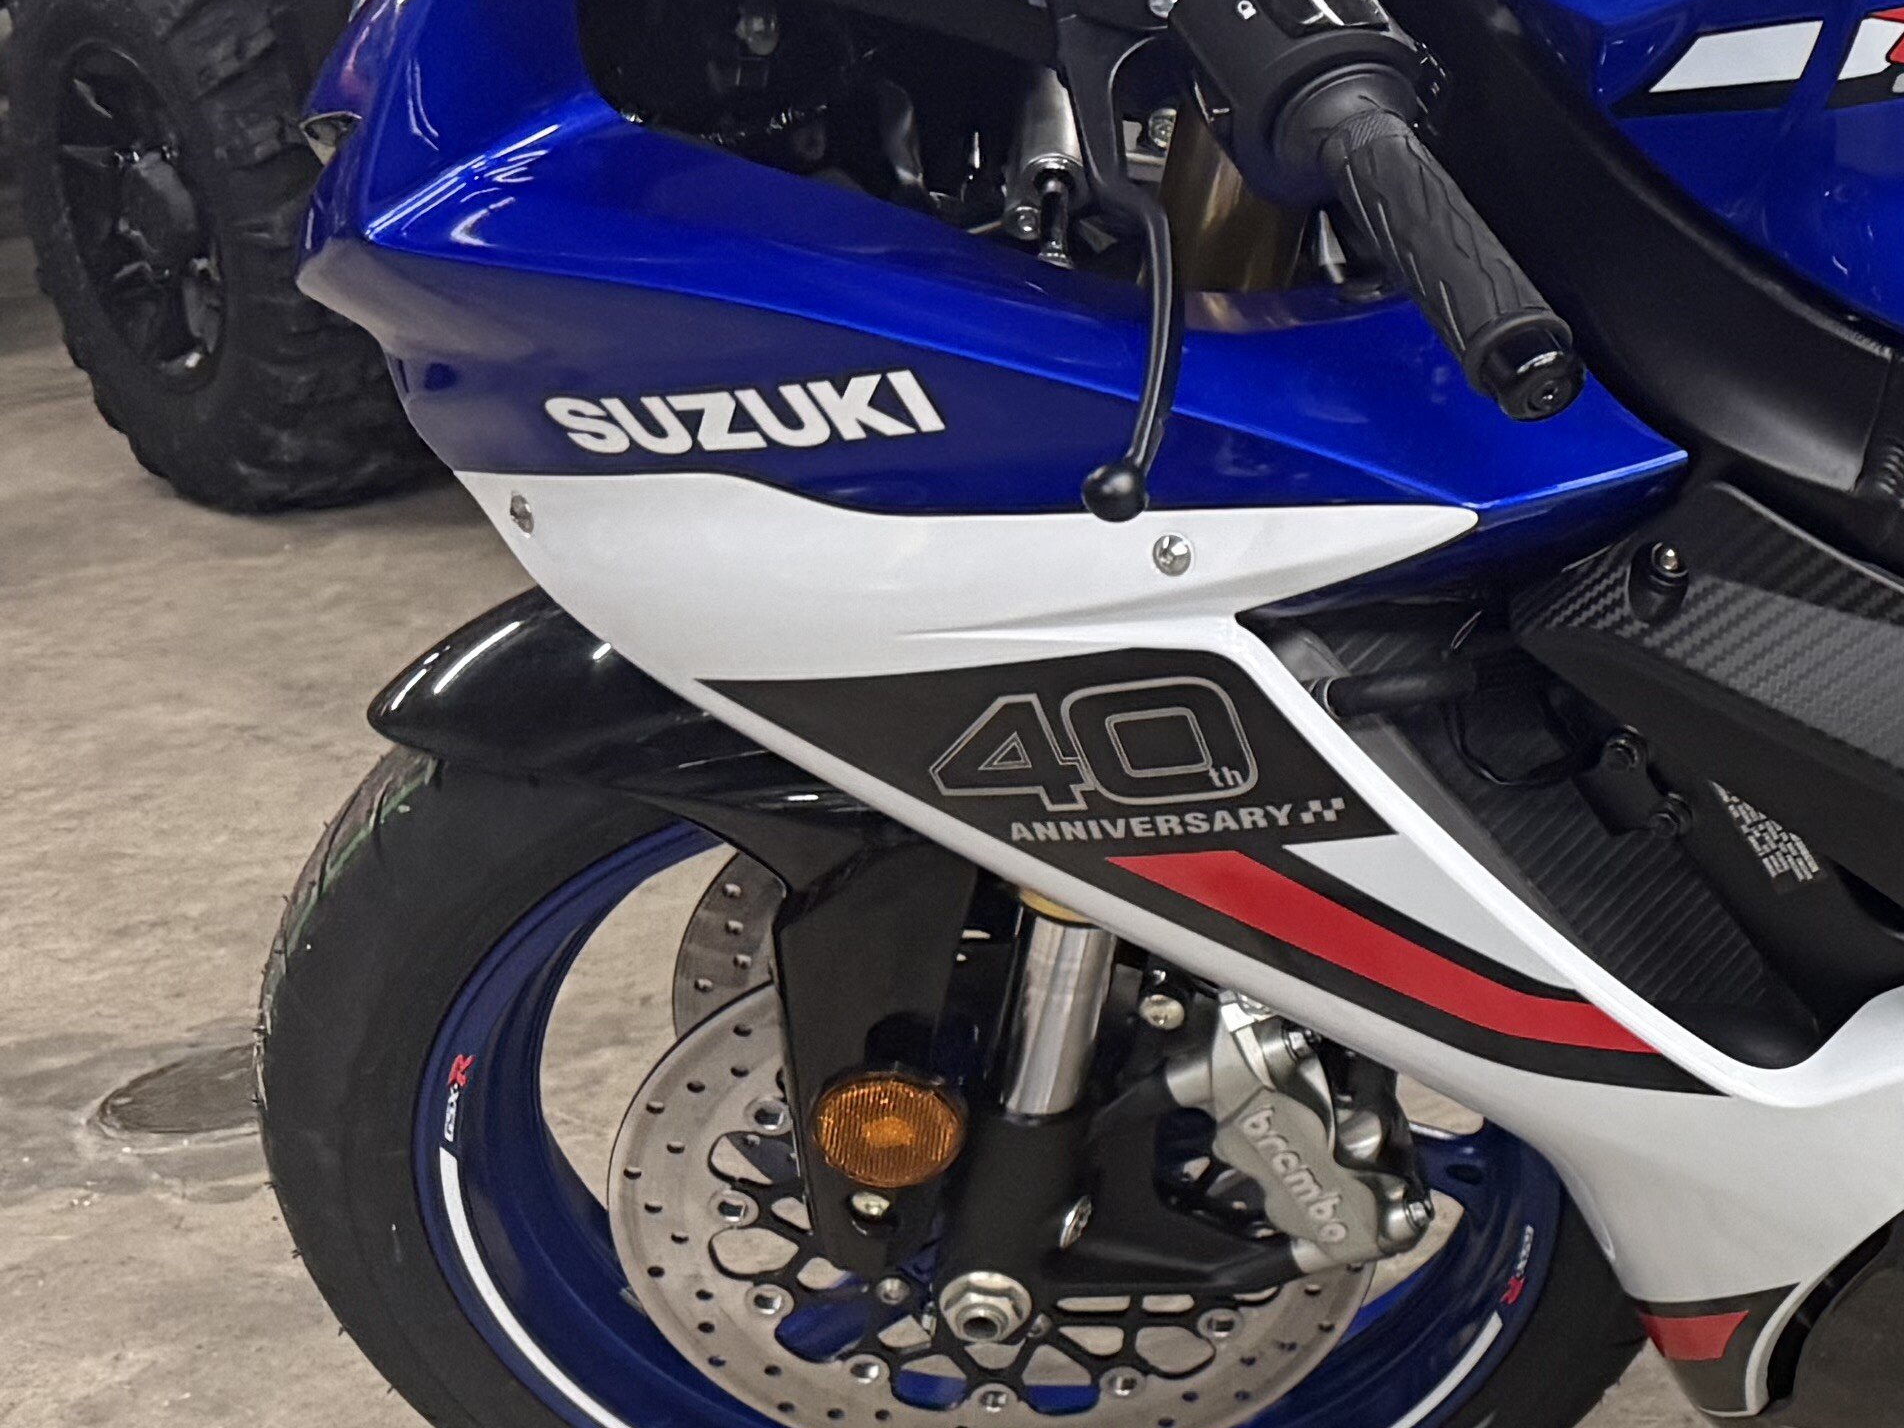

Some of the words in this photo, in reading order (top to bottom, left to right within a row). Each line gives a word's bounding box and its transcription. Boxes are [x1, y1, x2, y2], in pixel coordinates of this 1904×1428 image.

[544, 369, 946, 456] SUZUKI
[1009, 805, 1293, 842] ANNIVERSARY
[1241, 1105, 1350, 1246] brembo
